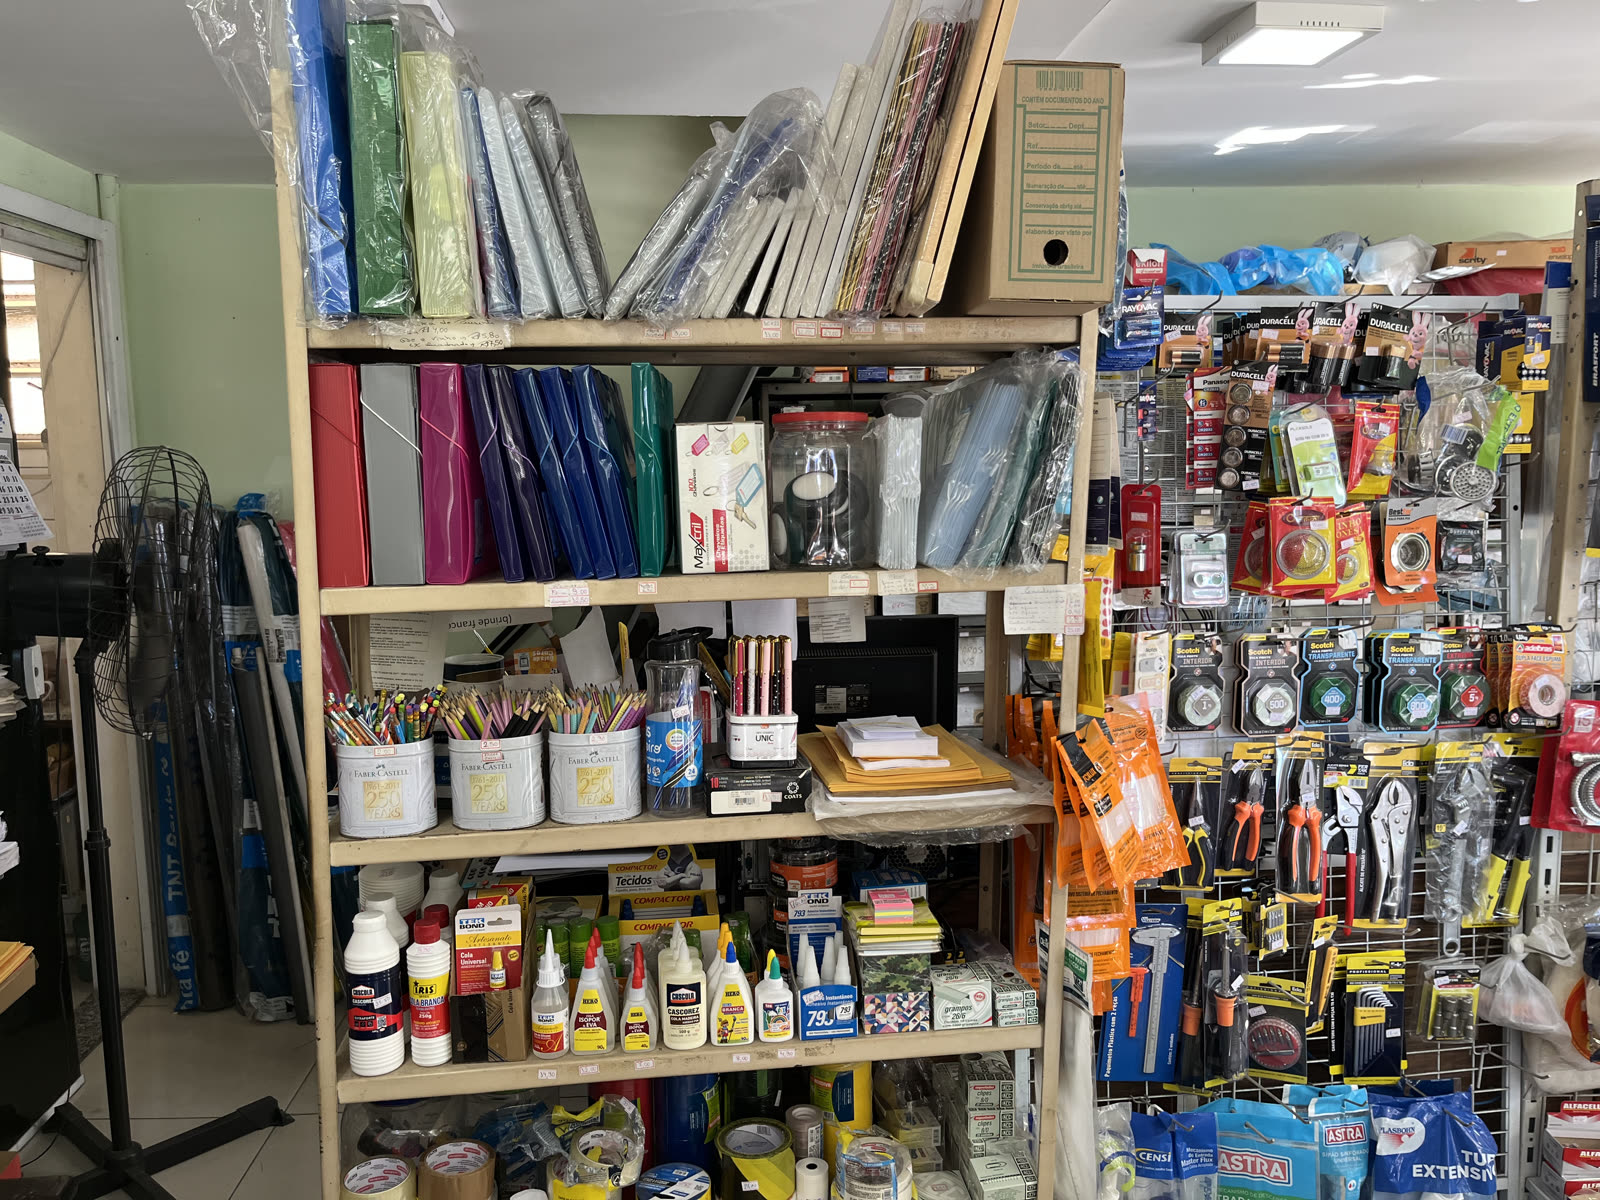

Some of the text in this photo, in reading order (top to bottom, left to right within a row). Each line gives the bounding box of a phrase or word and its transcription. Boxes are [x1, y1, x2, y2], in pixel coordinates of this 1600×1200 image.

[1458, 255, 1487, 264] scrity
[1122, 302, 1158, 313] RAYOVAC
[1370, 318, 1410, 333] DURACELL
[1231, 371, 1265, 380] DURACELL
[1309, 651, 1355, 659] TRANSPARENTE
[1270, 700, 1284, 708] 500
[1325, 695, 1339, 703] 400
[580, 776, 611, 794] 250
[472, 784, 504, 801] 250
[367, 791, 400, 808] 250
[581, 794, 612, 804] YEARS
[476, 801, 505, 812] YEARS
[368, 809, 400, 819] YEARS
[167, 855, 183, 901] TNT
[616, 875, 652, 886] Tecidos
[634, 895, 690, 904] COMPACTOR
[466, 935, 512, 944] Artesanato
[415, 986, 434, 994] IRIS
[421, 996, 444, 1006] BRANCA
[944, 1005, 972, 1013] grampos
[1329, 1127, 1362, 1141] ASTRA
[1181, 1158, 1199, 1167] Master
[1218, 1150, 1284, 1181] ASTRA
